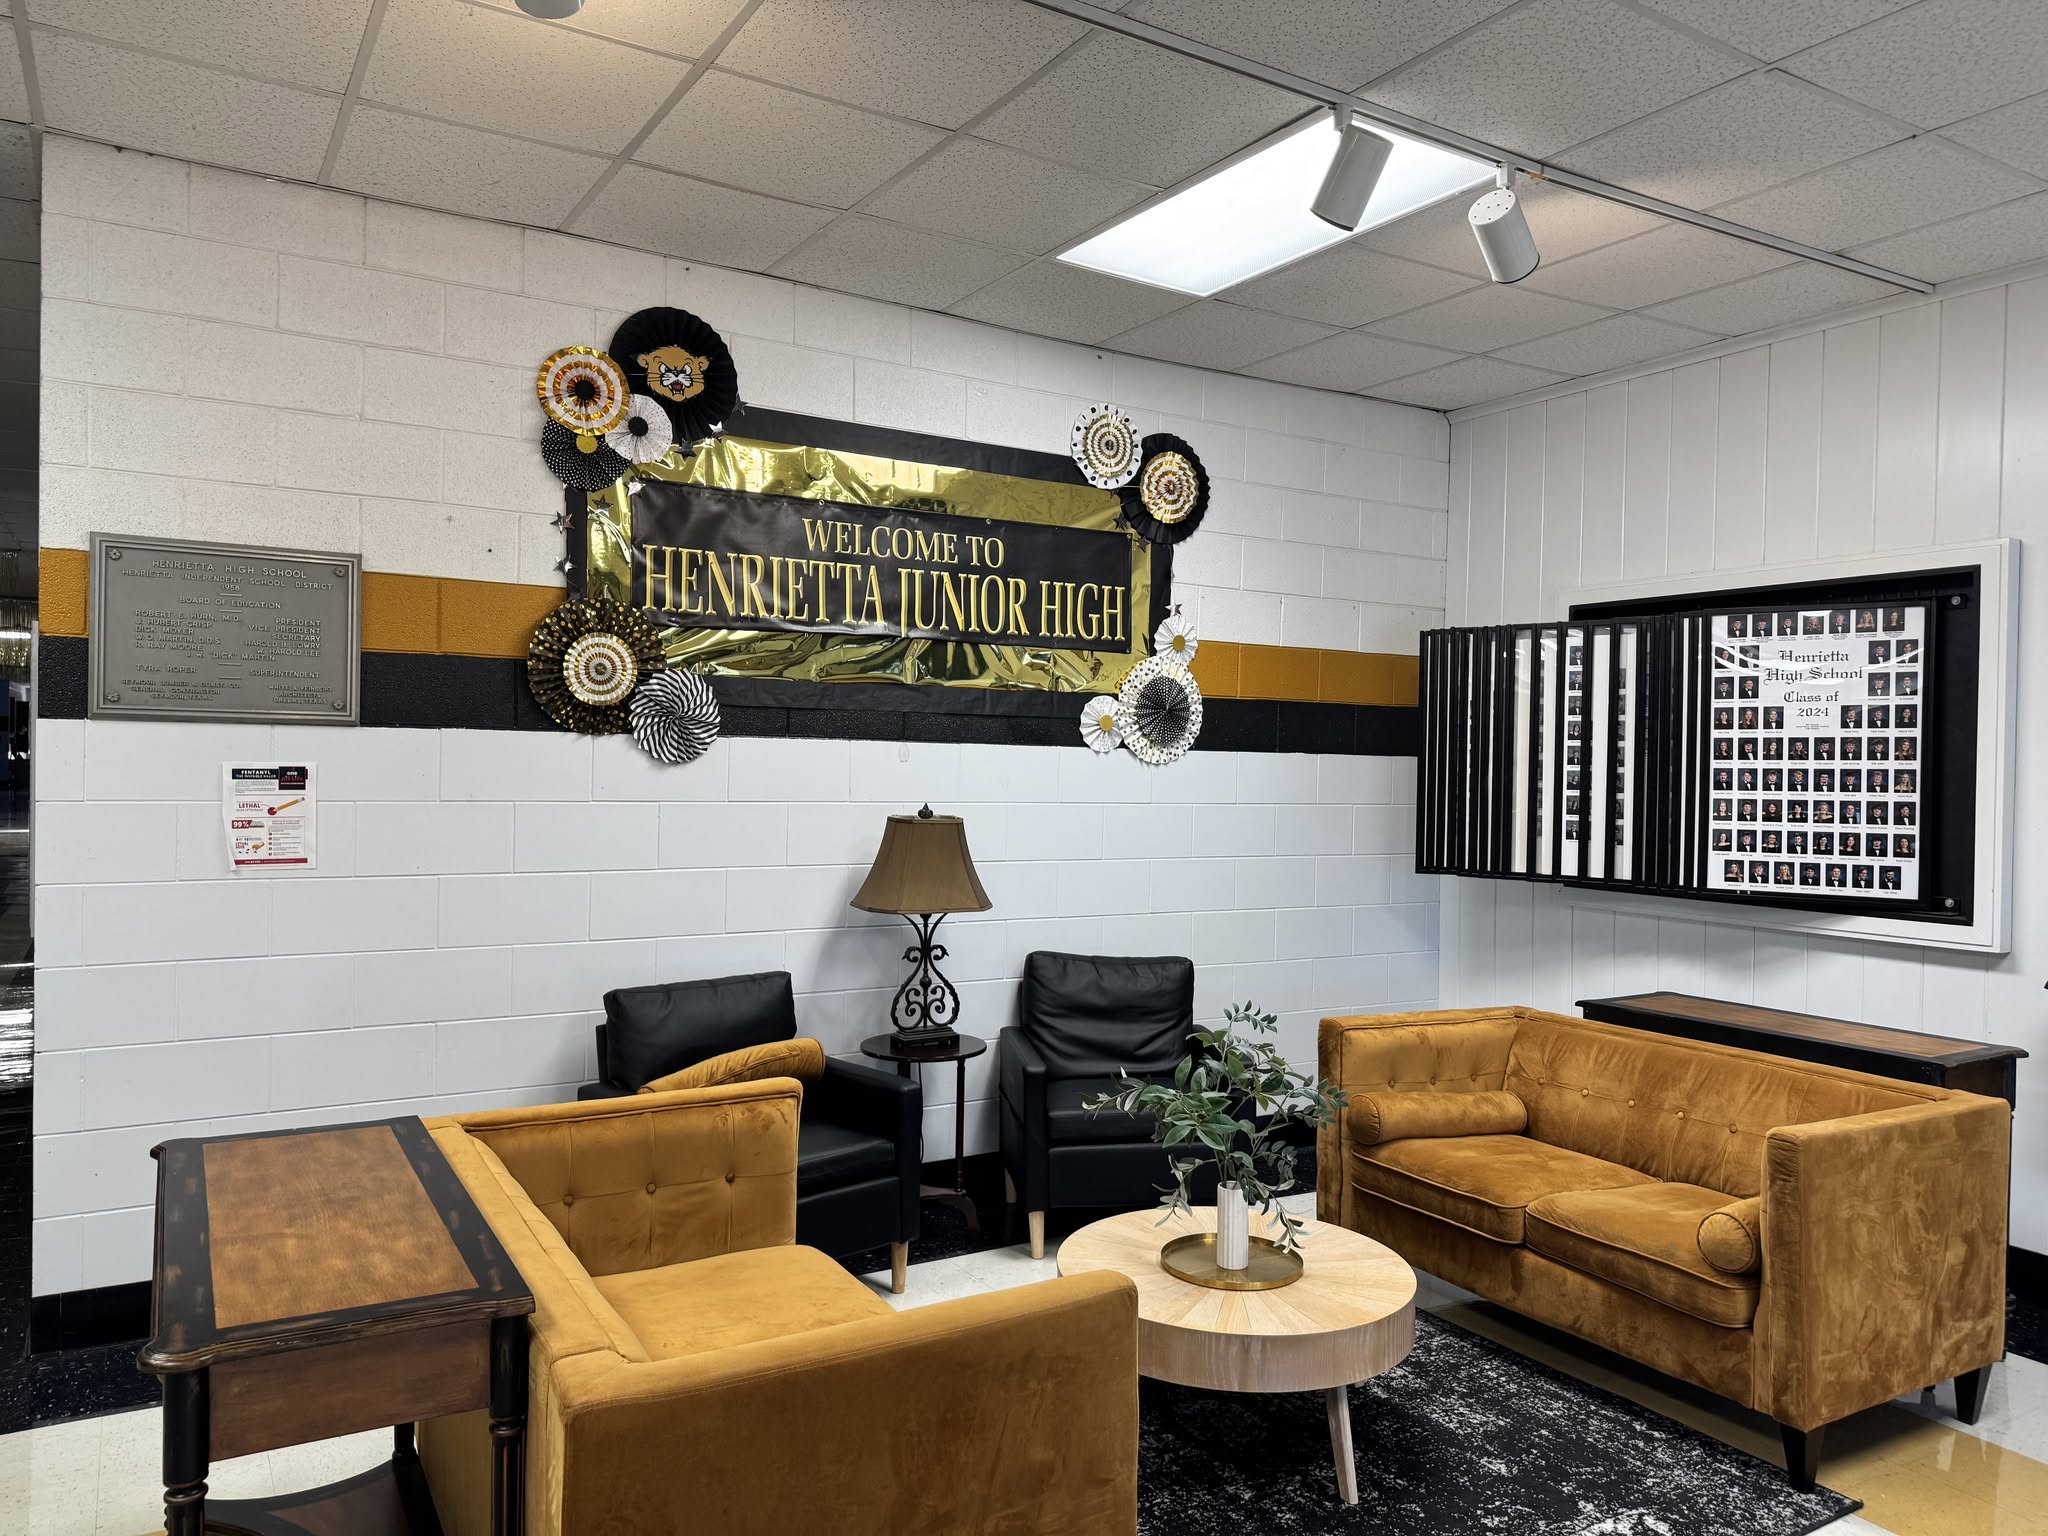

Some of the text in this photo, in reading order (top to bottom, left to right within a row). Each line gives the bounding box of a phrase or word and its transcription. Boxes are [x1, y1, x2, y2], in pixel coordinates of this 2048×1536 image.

[801, 518, 1006, 569] WELCOME TO
[152, 559, 307, 578] HENRIETTA HIGH SCHOOL
[122, 569, 333, 590] HENRIETTA INDEPENDENT SCHOOL DISTRICT
[222, 583, 240, 591] 1958
[642, 543, 1127, 641] HENRIETTA JUNIOR HIGH
[179, 596, 281, 609] BOARD OF EDUCATION
[135, 608, 172, 618] ROBERT
[147, 618, 182, 626] HUBERT
[185, 620, 212, 628] CRISP
[275, 617, 320, 626] PRESIDENT
[135, 625, 194, 635] DICK MOYER
[248, 624, 320, 634] VICE PRESIDENT
[271, 633, 320, 642] SECRETARY
[147, 642, 167, 650] RAY
[170, 643, 204, 651] MOORE
[293, 641, 320, 649] LOWRY
[269, 648, 302, 656] HAROLD
[1777, 649, 1849, 663] Henrietta
[166, 665, 197, 673] ROPER
[249, 669, 320, 679] SUPERINTENDENT
[1763, 666, 1863, 686] High School
[1784, 690, 1840, 703] Class of
[1796, 707, 1830, 717] 2024
